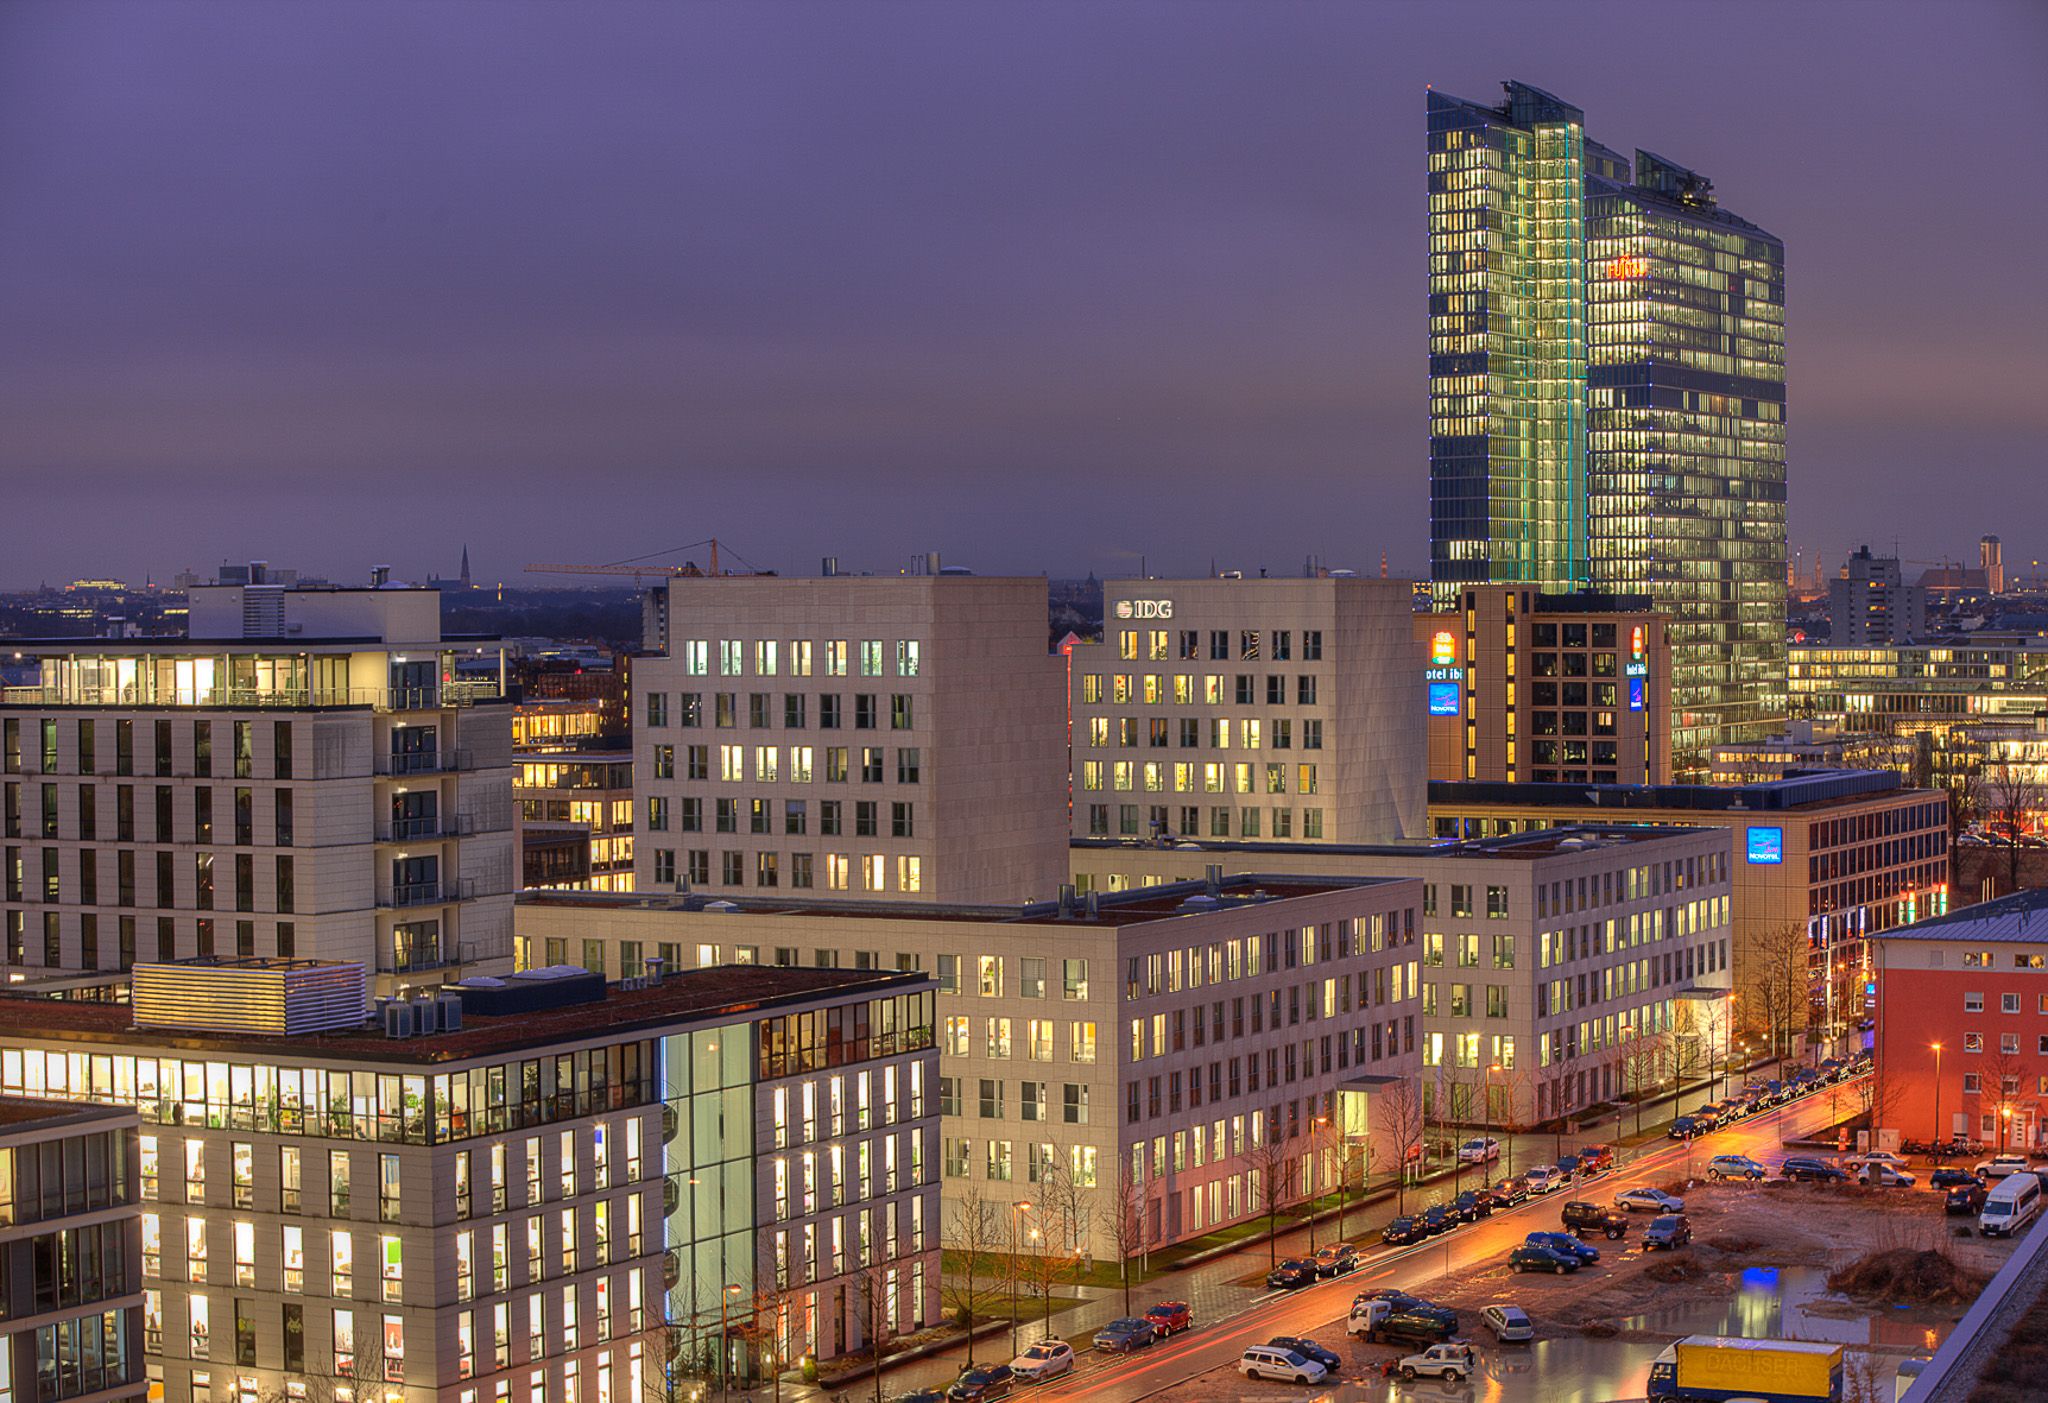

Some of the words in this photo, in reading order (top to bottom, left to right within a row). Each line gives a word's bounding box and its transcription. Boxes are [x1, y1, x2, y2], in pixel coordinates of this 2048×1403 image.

[1135, 600, 1172, 618] IDG
[1426, 668, 1446, 680] otel
[1450, 668, 1463, 680] ibi
[1707, 1354, 1800, 1376] DACHSER
